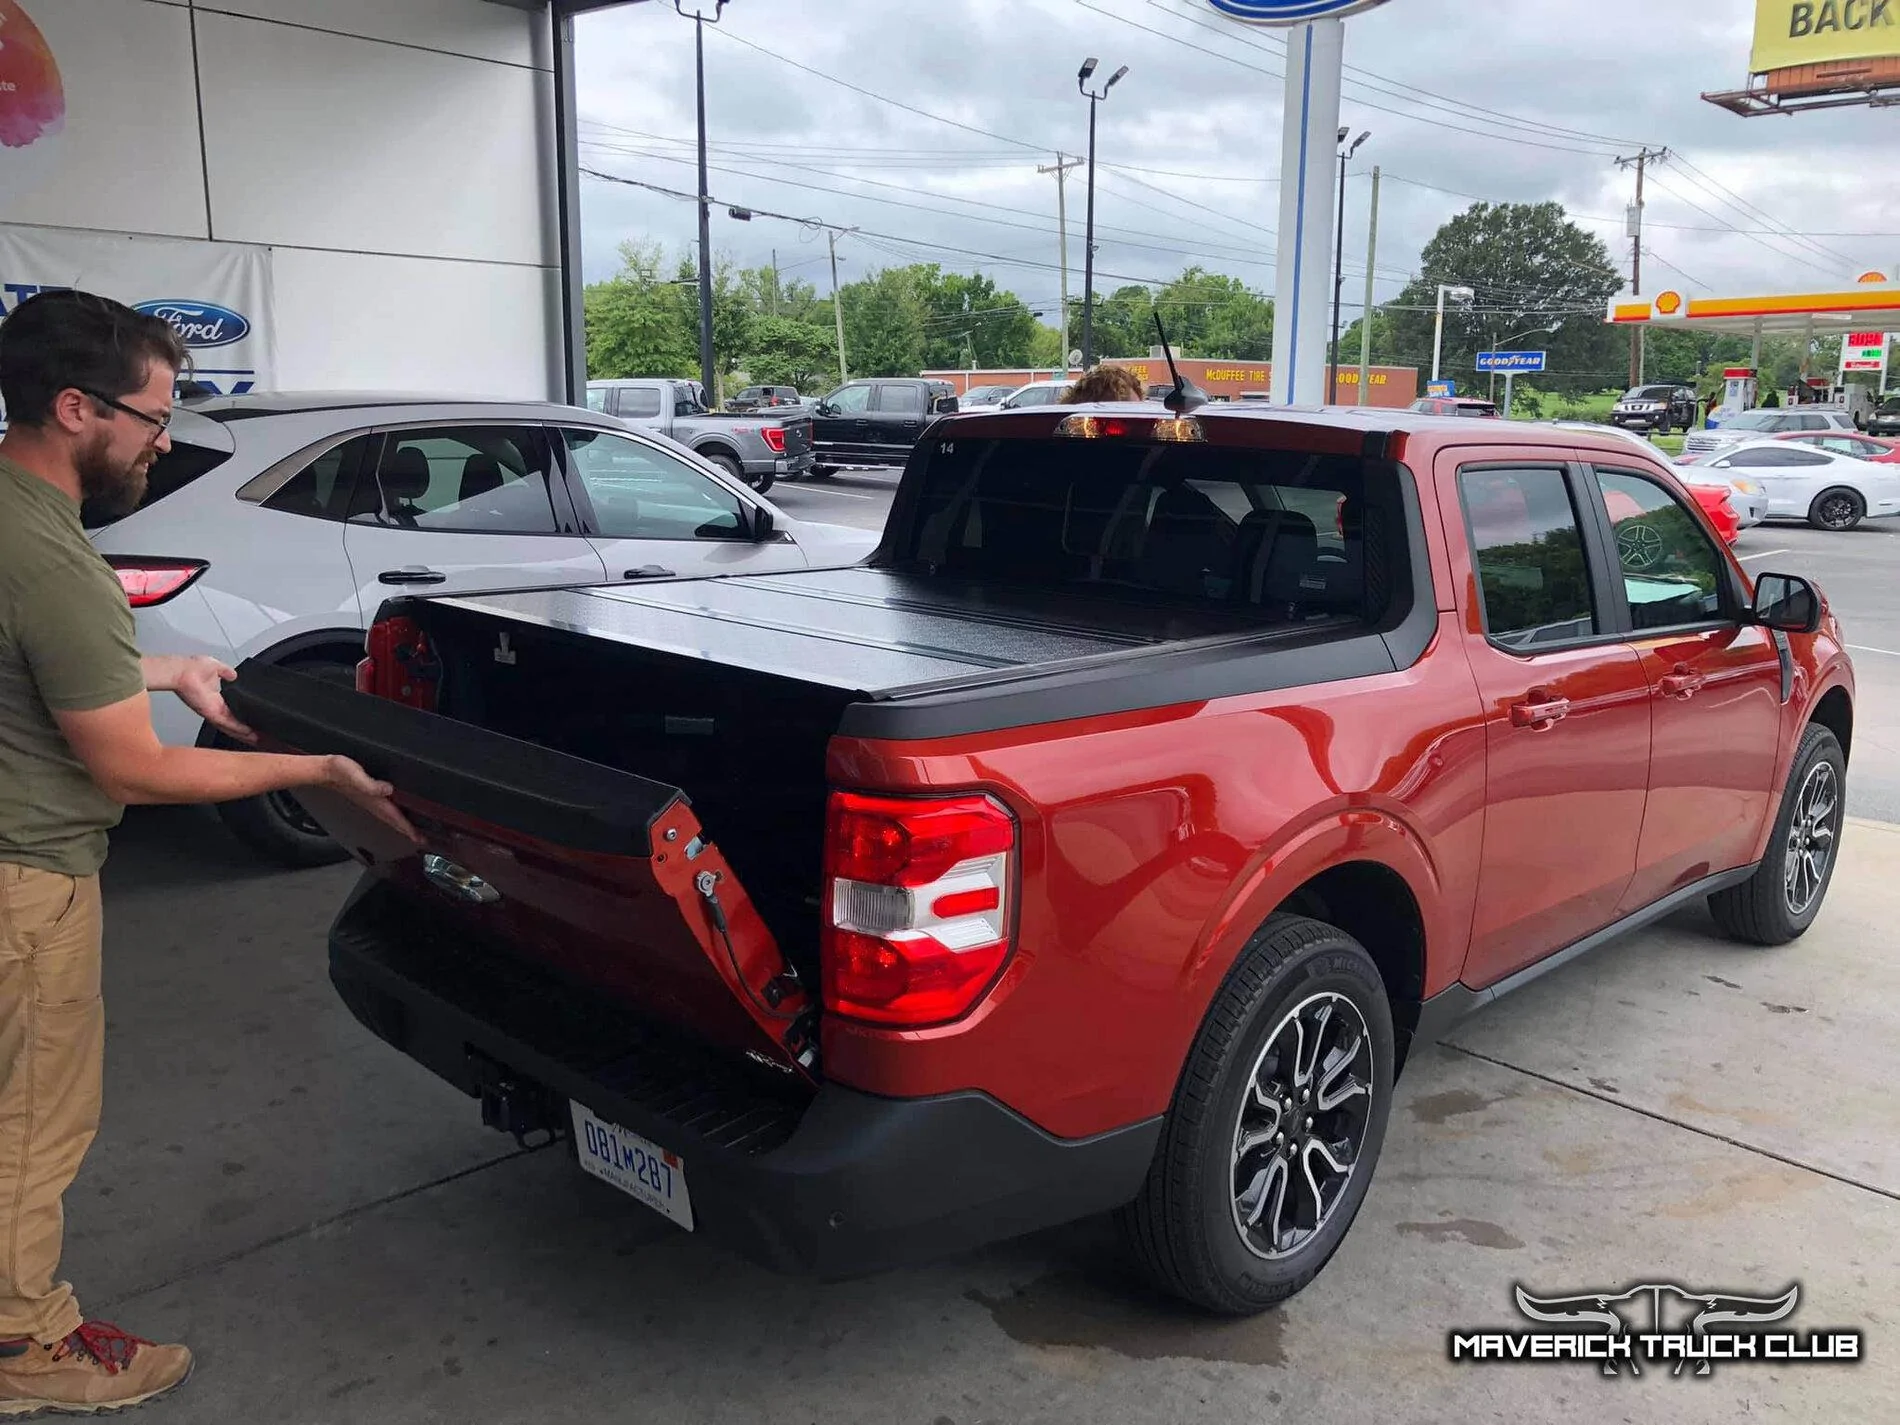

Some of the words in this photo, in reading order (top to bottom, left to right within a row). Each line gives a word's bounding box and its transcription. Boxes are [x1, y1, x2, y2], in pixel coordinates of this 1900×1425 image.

[1789, 0, 1895, 37] BACK
[1479, 356, 1541, 366] GOODYEAR
[1249, 370, 1265, 381] TIRE
[940, 442, 954, 454] 14
